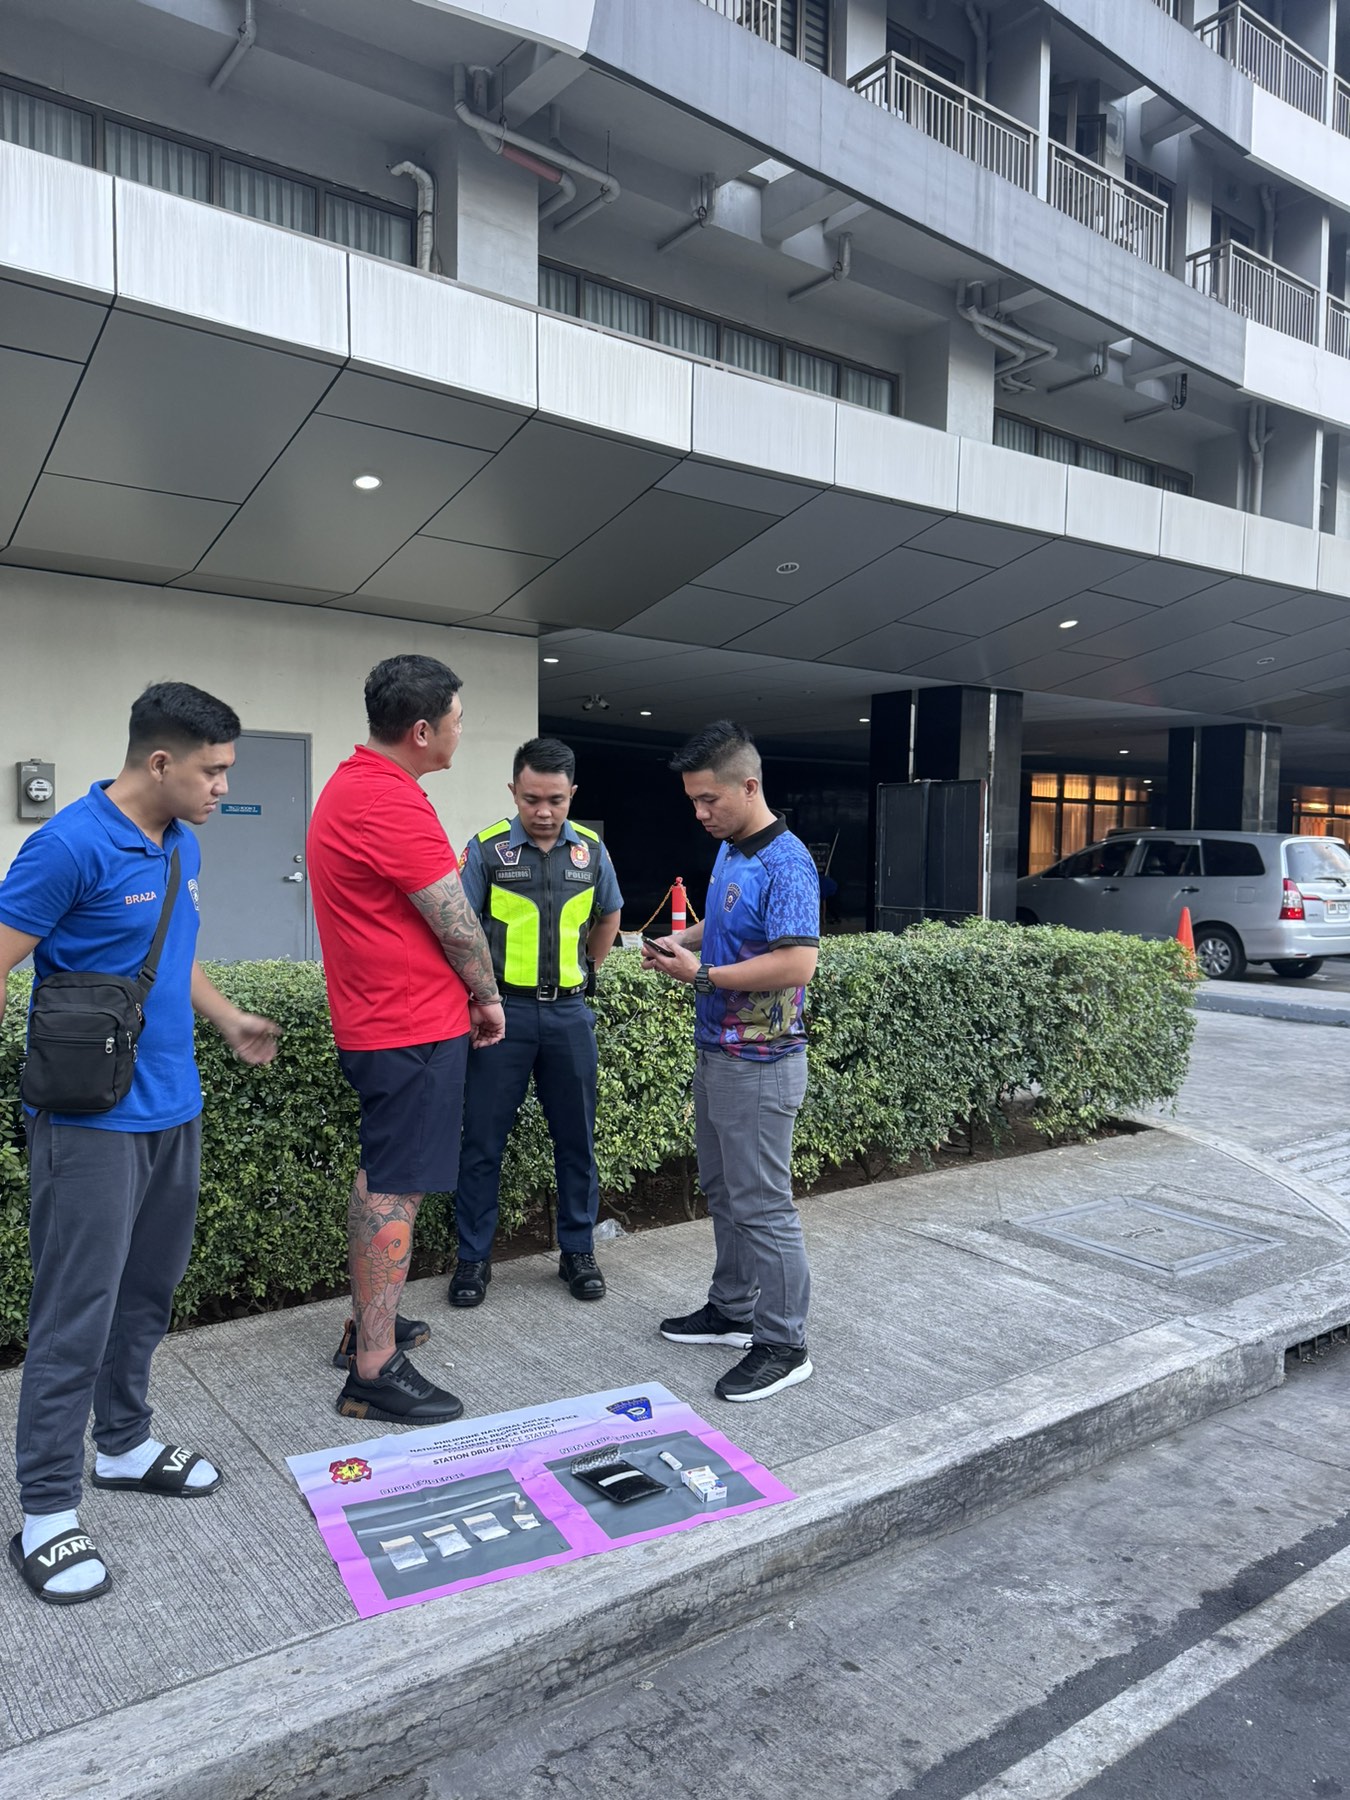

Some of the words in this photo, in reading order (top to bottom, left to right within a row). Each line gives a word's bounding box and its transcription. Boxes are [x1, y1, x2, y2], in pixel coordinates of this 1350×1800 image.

[567, 870, 592, 880] POLICE
[125, 891, 157, 905] BRAZA
[409, 1443, 453, 1453] NATIONAL
[454, 1436, 489, 1446] CAPITAL
[489, 1427, 521, 1439] REGION
[521, 1420, 551, 1429] POLICE
[551, 1414, 579, 1423] OFFICE
[434, 1433, 480, 1446] PHILIPPINE
[481, 1423, 522, 1436] NATIONAL
[522, 1416, 551, 1425] POLICE
[489, 1431, 520, 1443] POLICE
[520, 1423, 556, 1435] DISTRICT
[524, 1429, 558, 1441] STATION
[433, 1452, 470, 1466] STATION
[470, 1446, 495, 1457] DRUG
[37, 1535, 97, 1568] VANS
